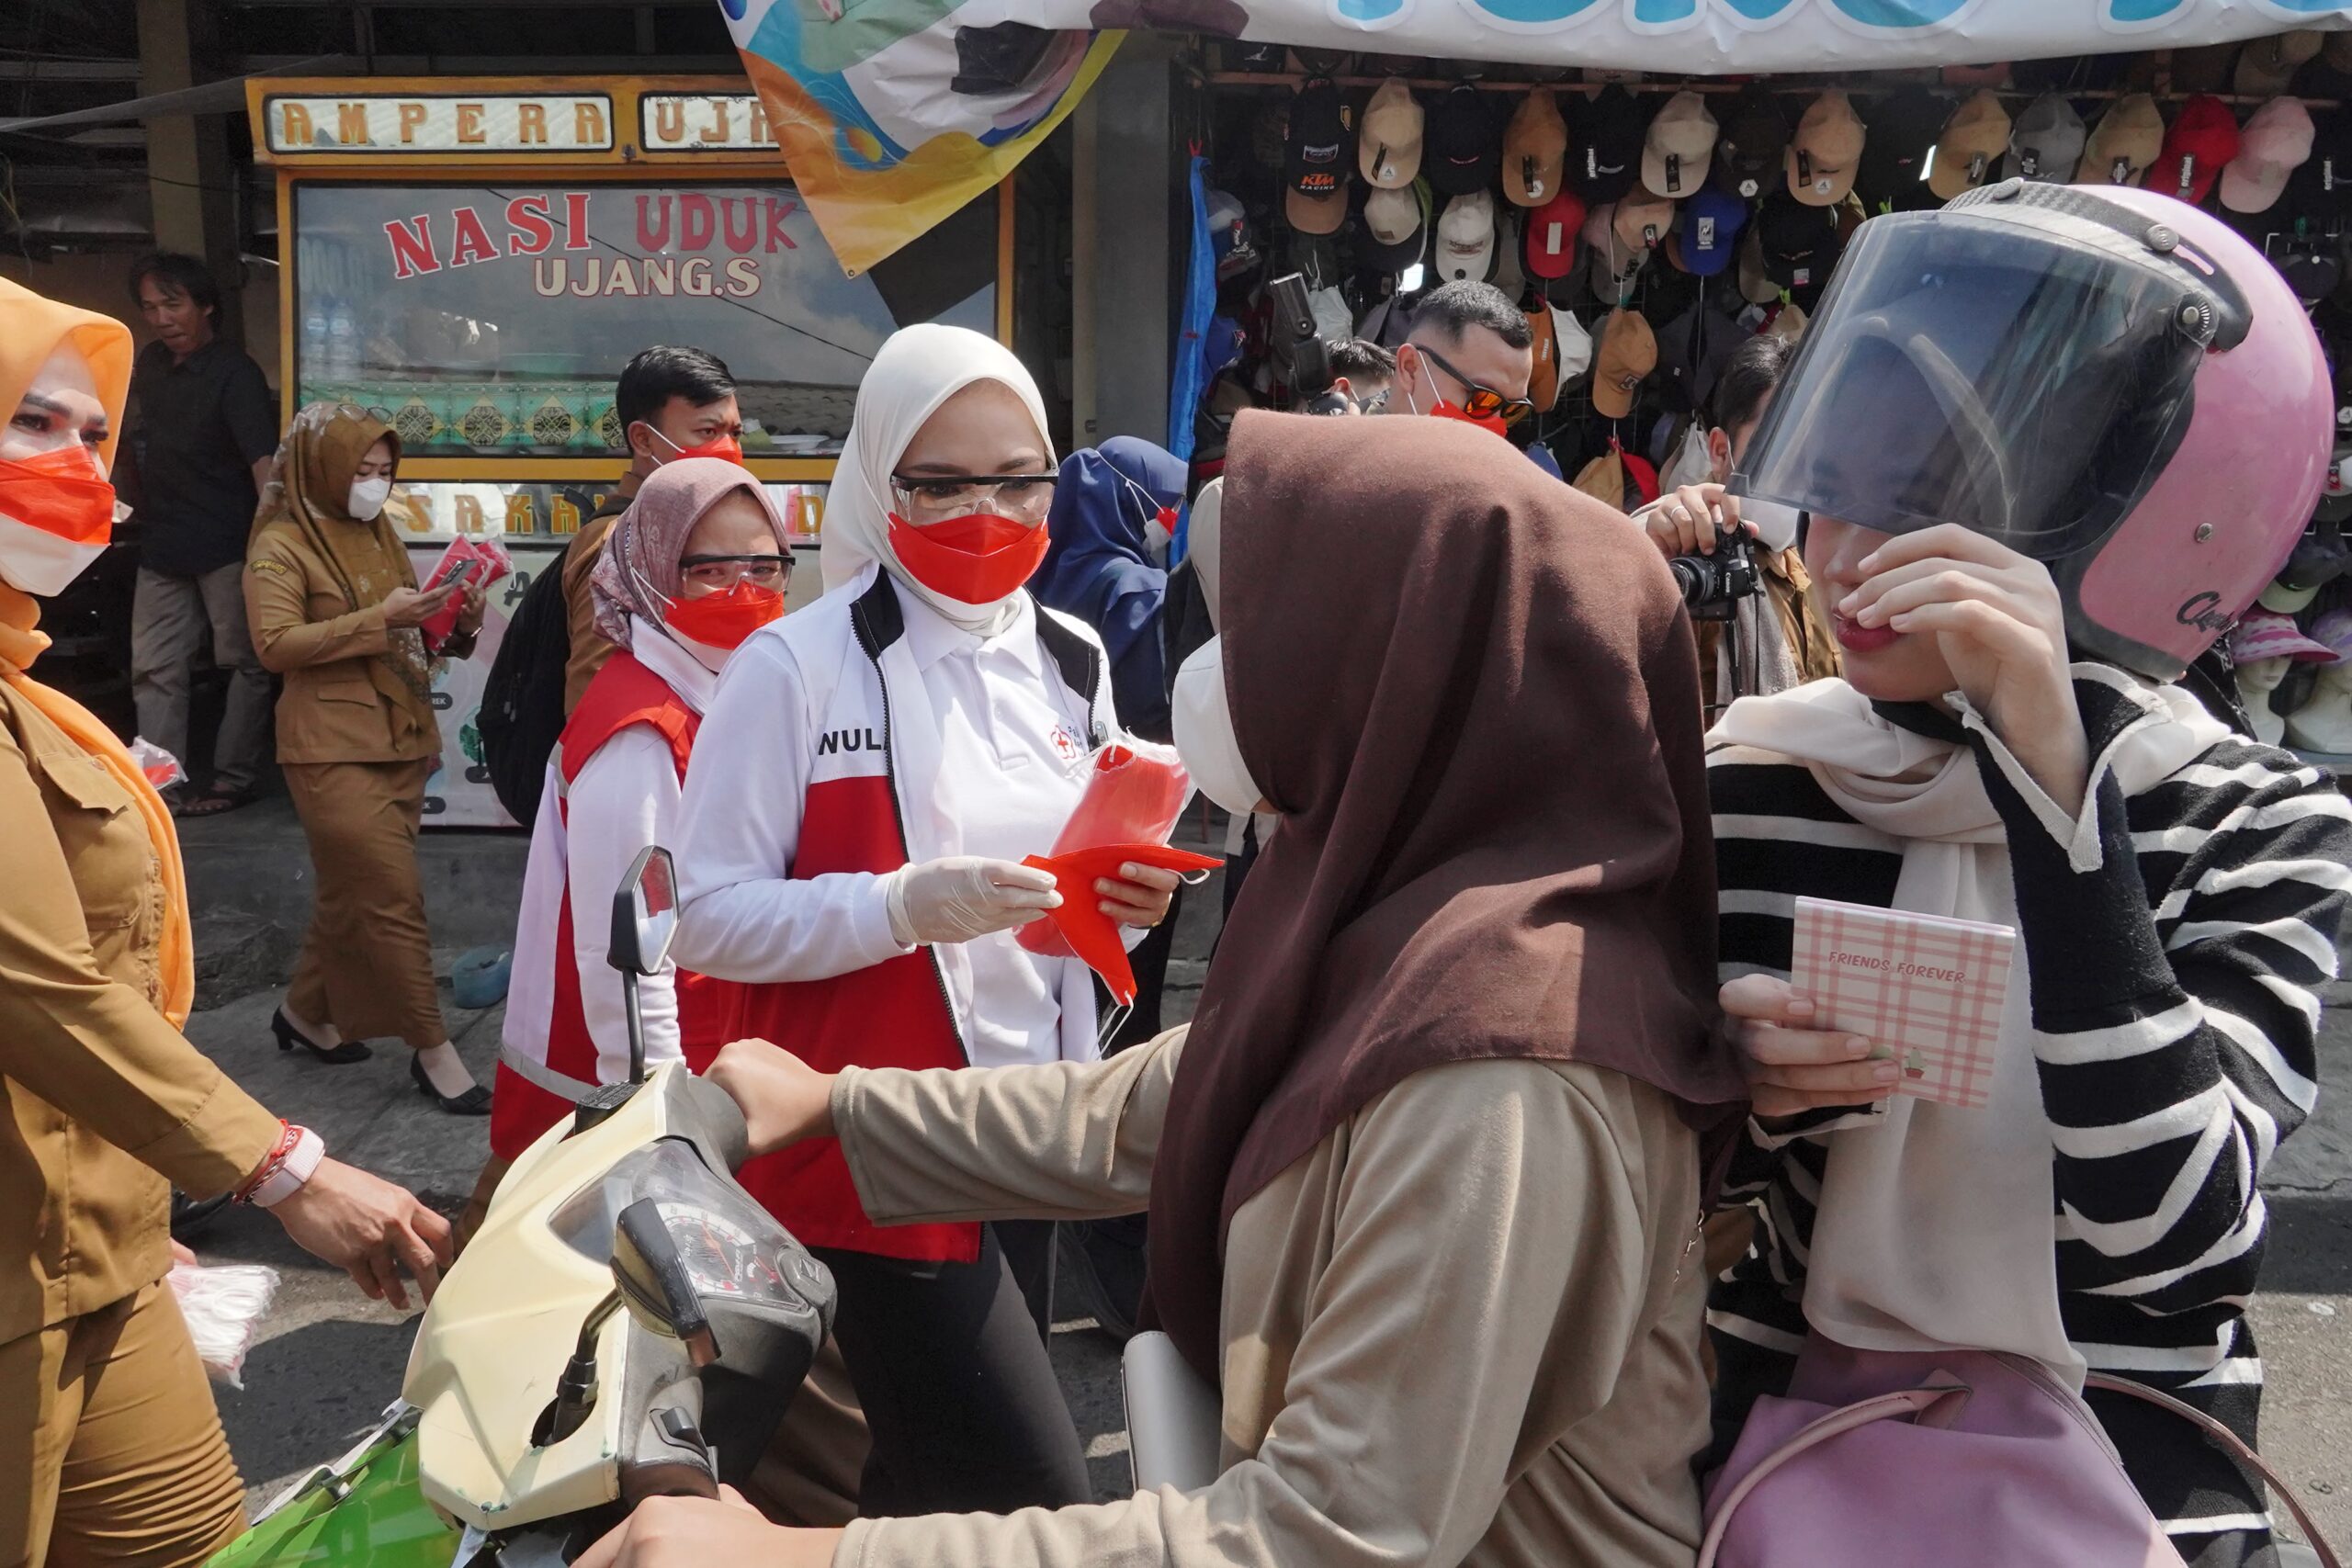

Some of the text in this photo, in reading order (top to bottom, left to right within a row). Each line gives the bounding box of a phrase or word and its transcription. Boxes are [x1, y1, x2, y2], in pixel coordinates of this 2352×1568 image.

[282, 102, 605, 145] AMPERA
[1301, 174, 1335, 186] KTM
[383, 192, 797, 279] NASI UDUK
[534, 256, 762, 299] UJANG.S
[1829, 952, 1966, 983] FRIENDS FOREVER
